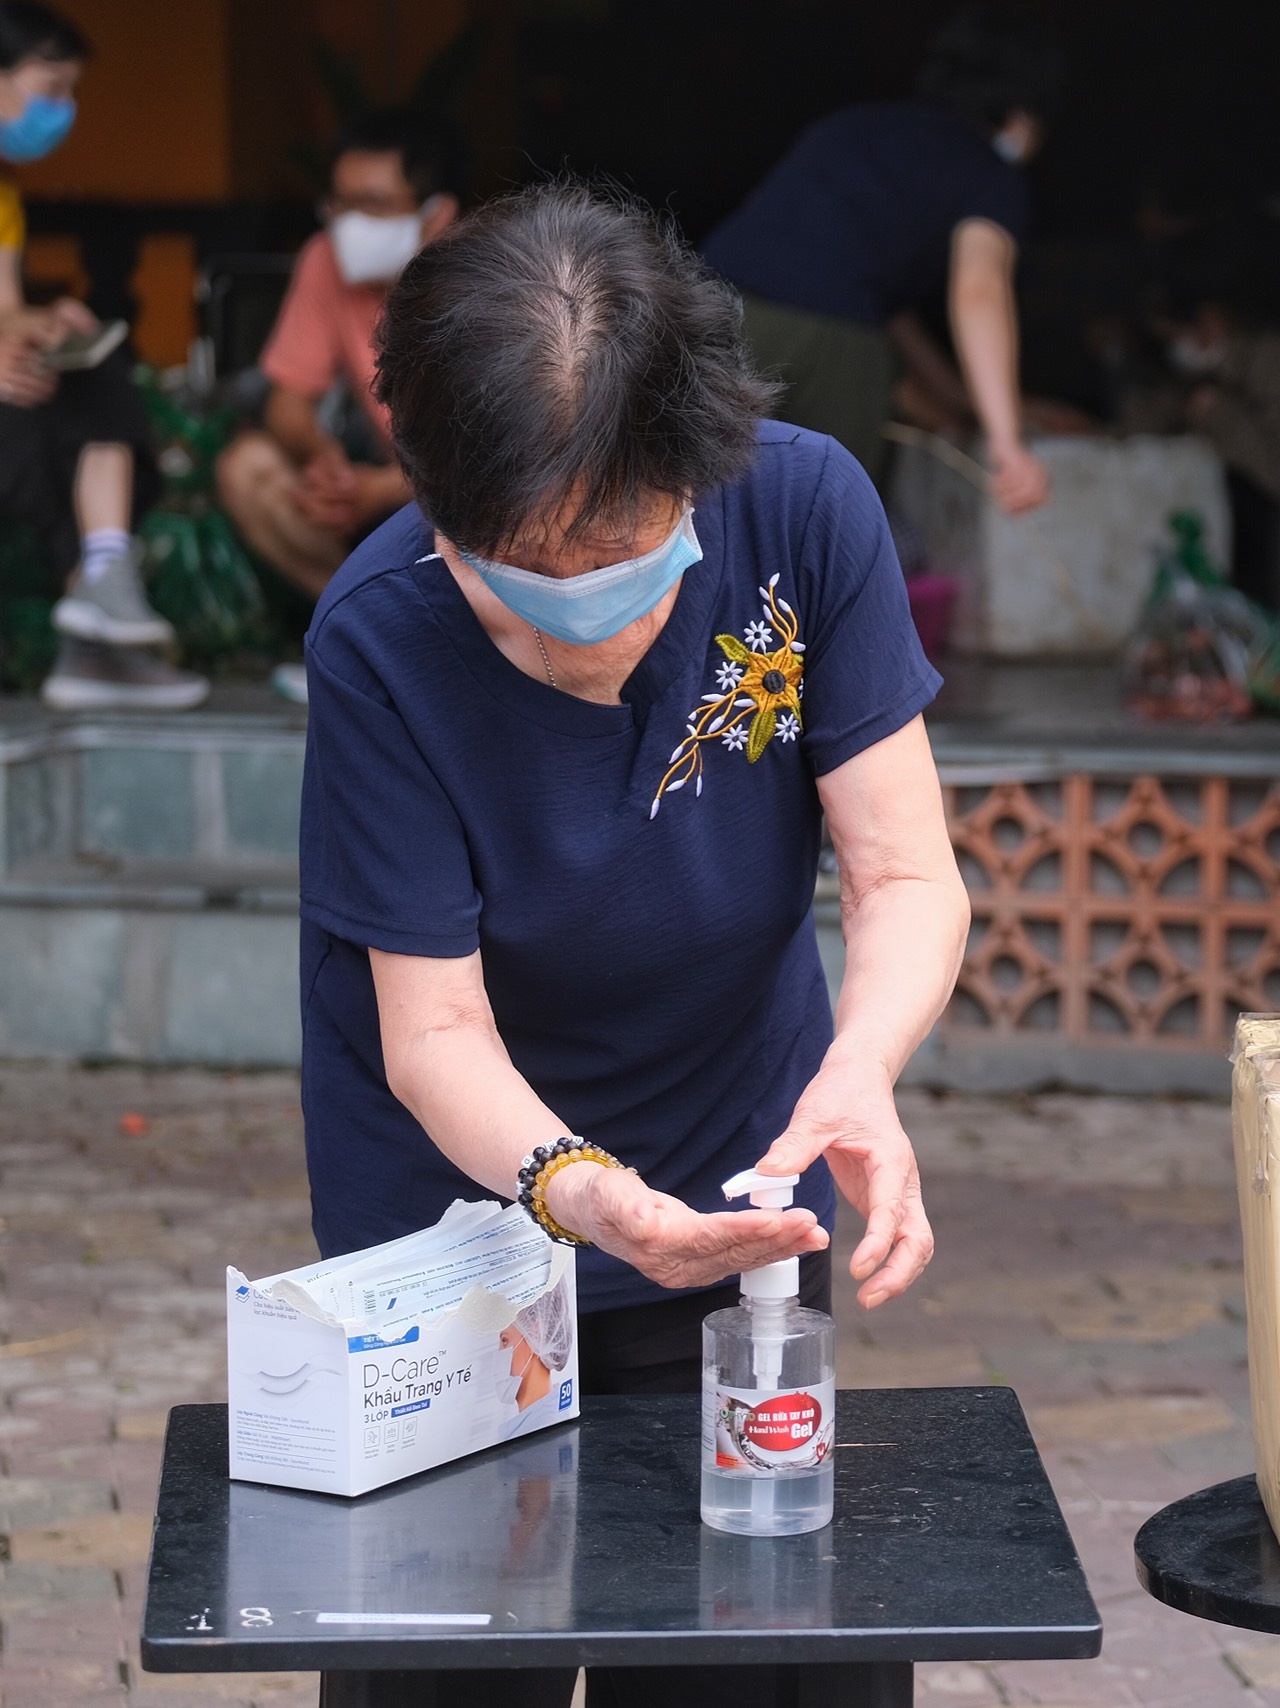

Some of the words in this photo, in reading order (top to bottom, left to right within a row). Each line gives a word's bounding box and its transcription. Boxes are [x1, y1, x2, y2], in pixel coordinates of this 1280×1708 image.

[363, 1356, 439, 1389] D-Care
[363, 1386, 402, 1409] Khẩu
[405, 1379, 443, 1399] Trang
[445, 1372, 455, 1388] Y
[456, 1364, 473, 1385] Tế
[561, 1383, 571, 1399] 50
[363, 1414, 370, 1424] 3
[758, 1413, 771, 1422] GEL
[792, 1422, 813, 1439] Gel
